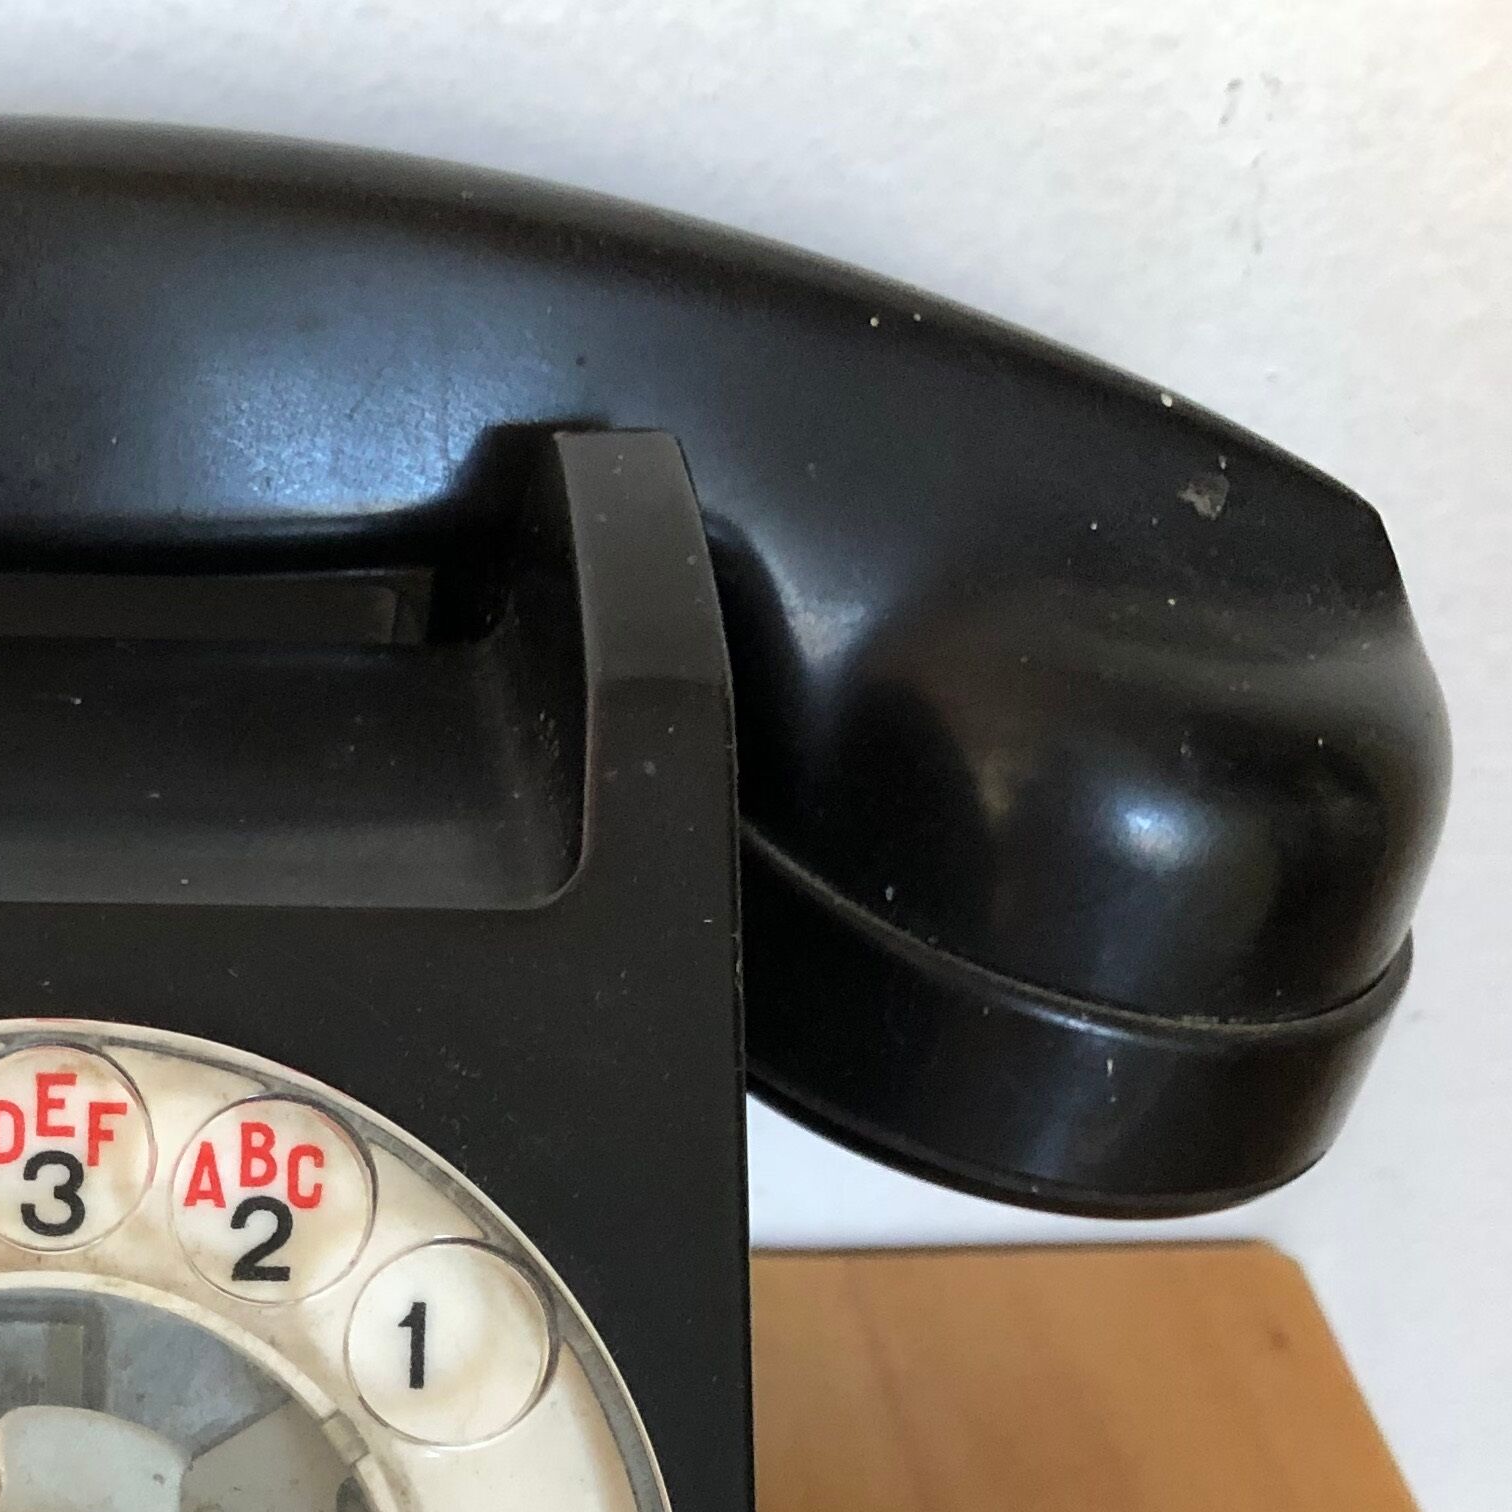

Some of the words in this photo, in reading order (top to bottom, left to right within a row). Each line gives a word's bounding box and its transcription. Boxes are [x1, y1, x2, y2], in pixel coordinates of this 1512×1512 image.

[20, 1150, 86, 1237] 3
[184, 1121, 325, 1210] ABC
[230, 1195, 293, 1282] 2
[398, 1302, 427, 1389] 1
